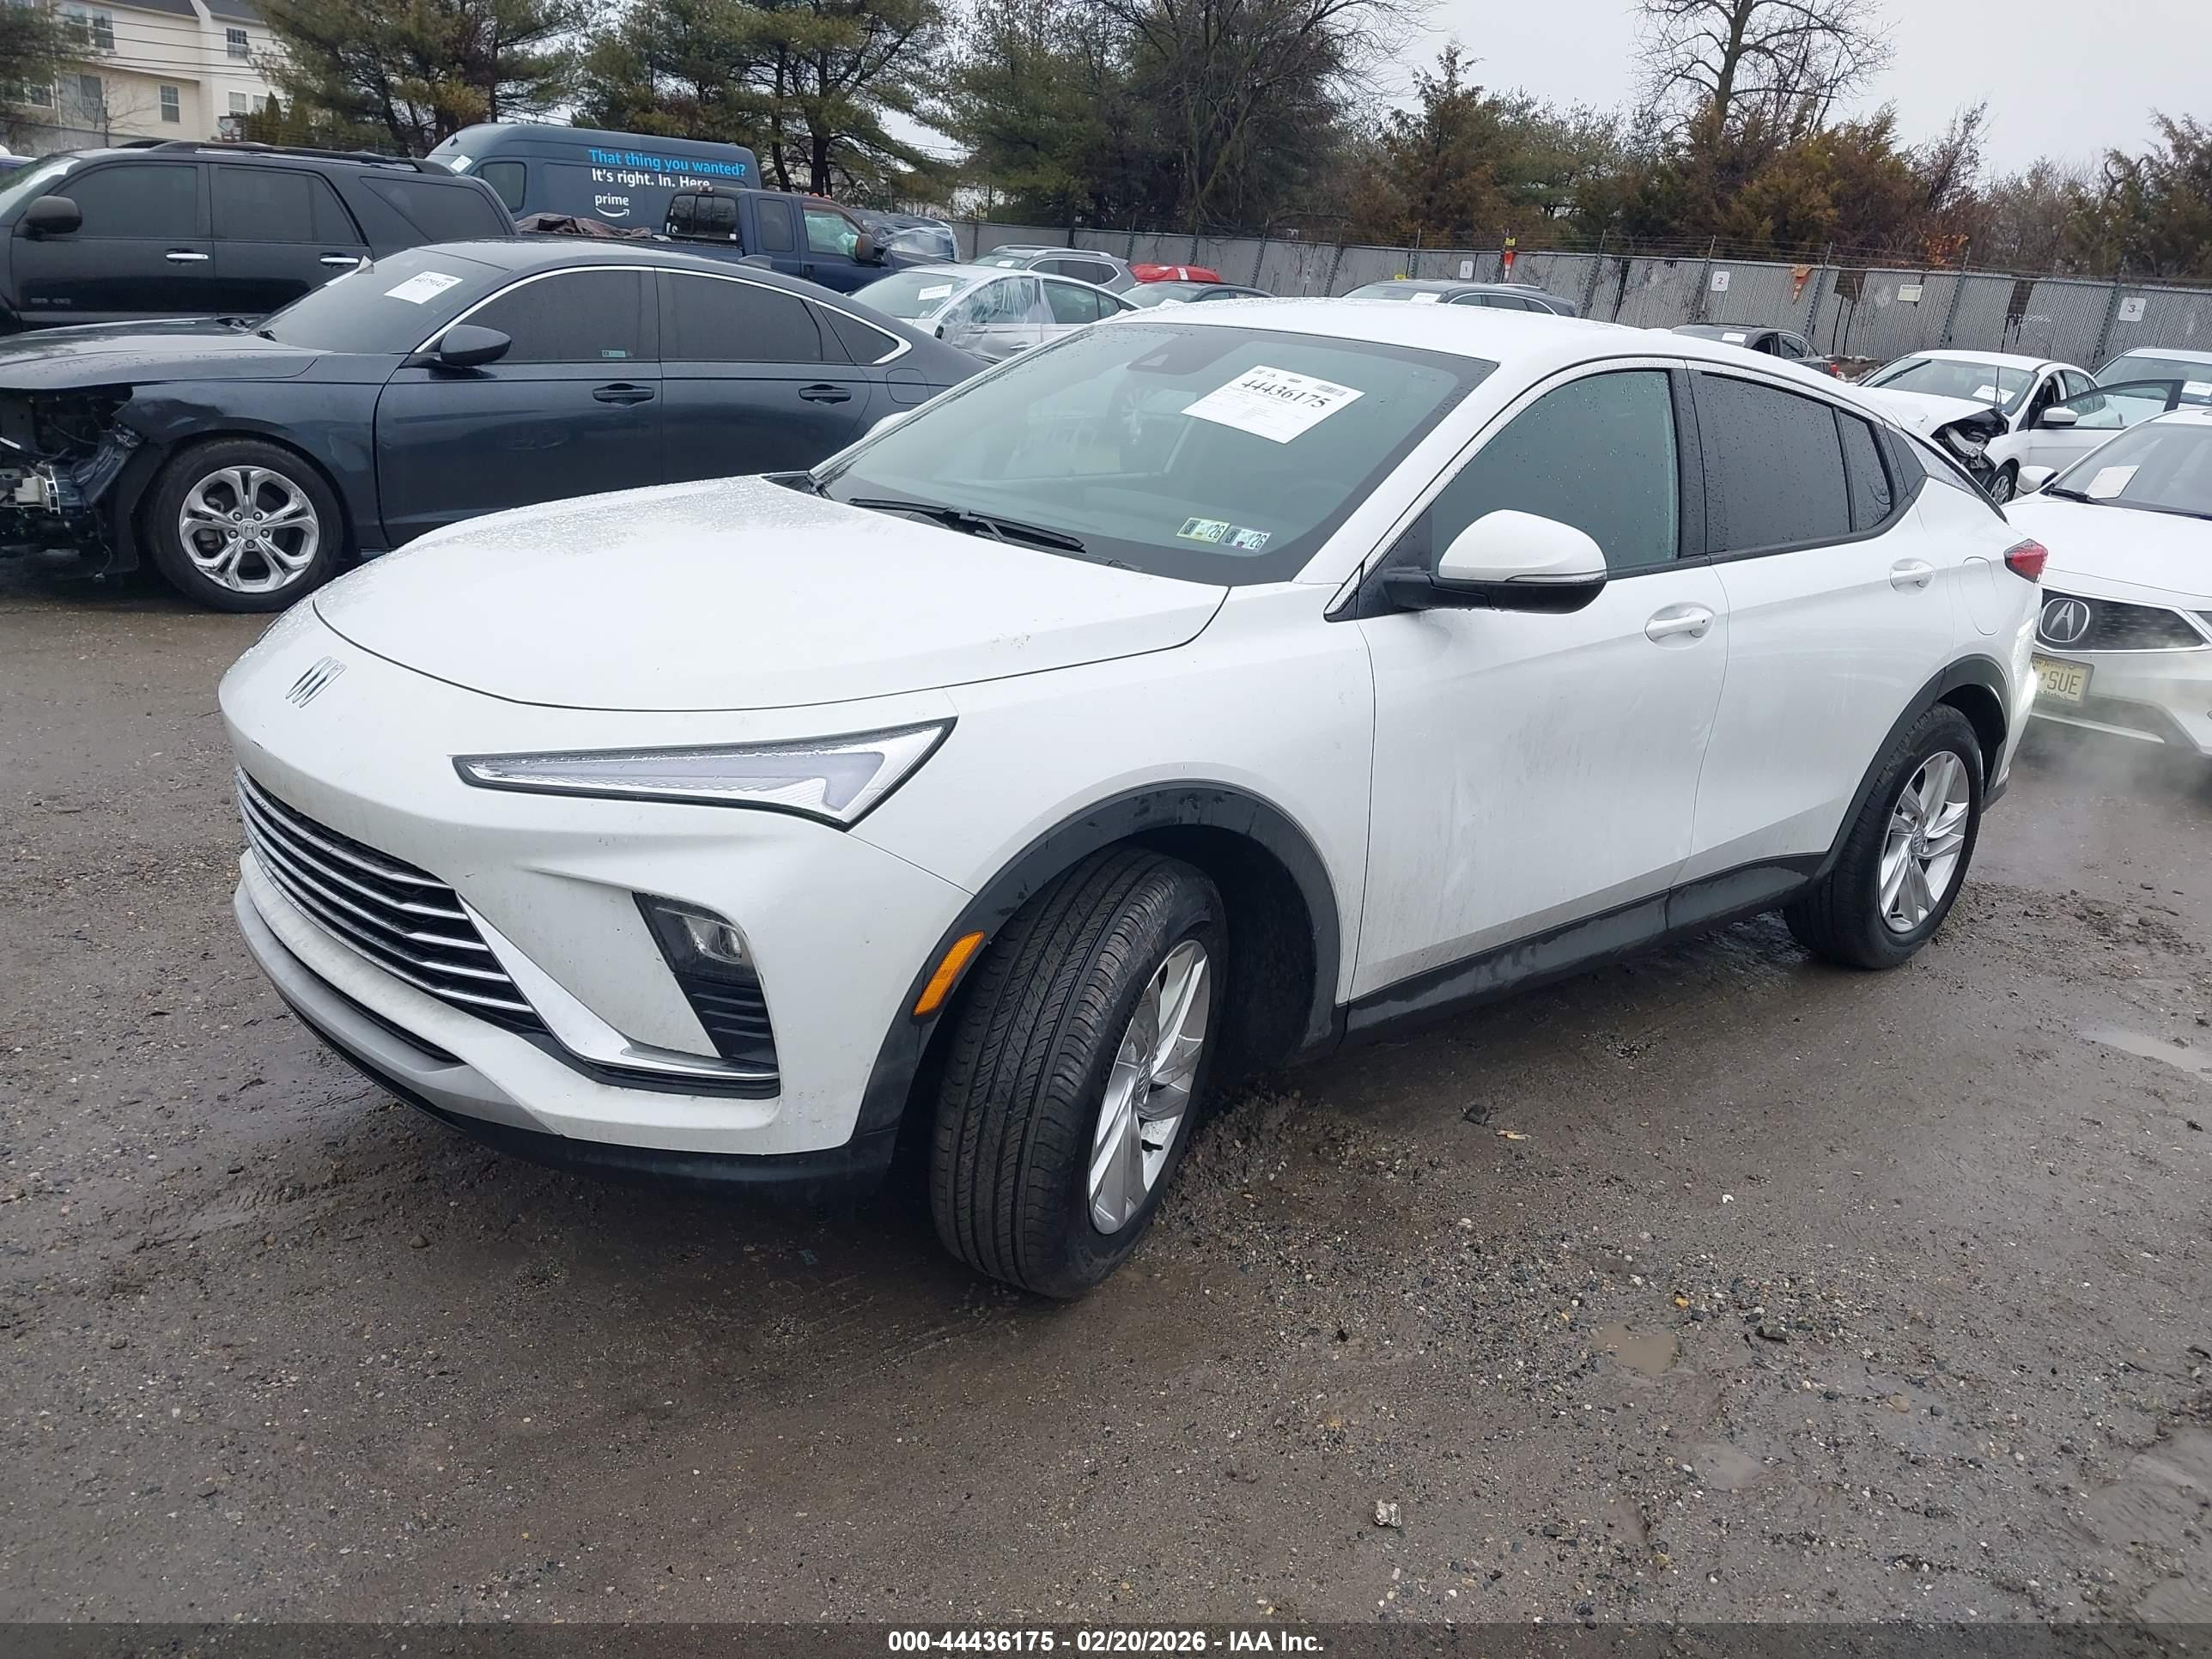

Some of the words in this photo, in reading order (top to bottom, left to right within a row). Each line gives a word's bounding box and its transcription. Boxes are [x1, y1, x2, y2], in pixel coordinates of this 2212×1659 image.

[588, 149, 621, 165] That
[624, 153, 661, 171] thing
[665, 158, 689, 172] you
[691, 161, 746, 176] wanted?
[592, 167, 614, 183] It's
[617, 170, 654, 187] right.
[658, 173, 676, 187] In.
[594, 192, 629, 207] prime
[2128, 304, 2136, 313] 3
[1242, 379, 1332, 408] 44436175
[1183, 522, 1195, 535] 3
[1208, 524, 1225, 539] 26
[1224, 531, 1237, 544] 3
[1249, 533, 1267, 549] 26
